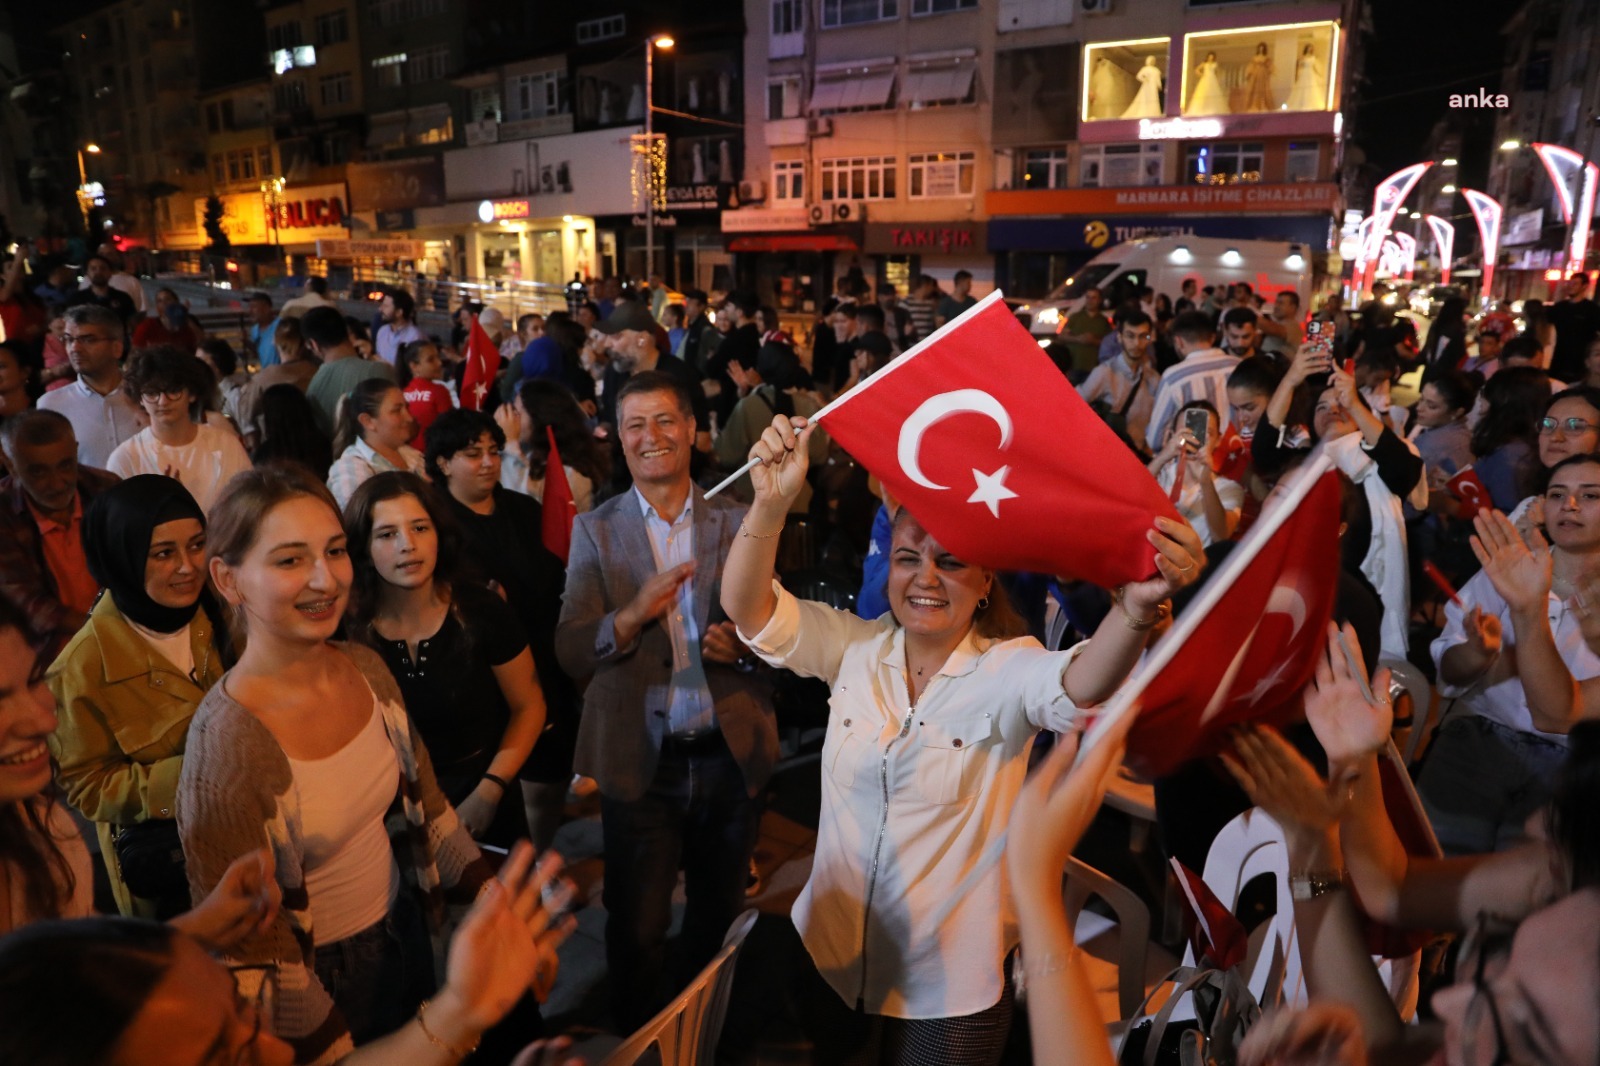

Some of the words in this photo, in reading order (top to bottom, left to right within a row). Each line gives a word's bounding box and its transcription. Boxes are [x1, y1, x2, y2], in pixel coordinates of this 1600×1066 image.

[1115, 190, 1190, 206] MARMARA
[1193, 186, 1243, 206] İŞİTME
[1246, 185, 1331, 204] CİHAZLARI
[494, 200, 529, 218] BOSCH
